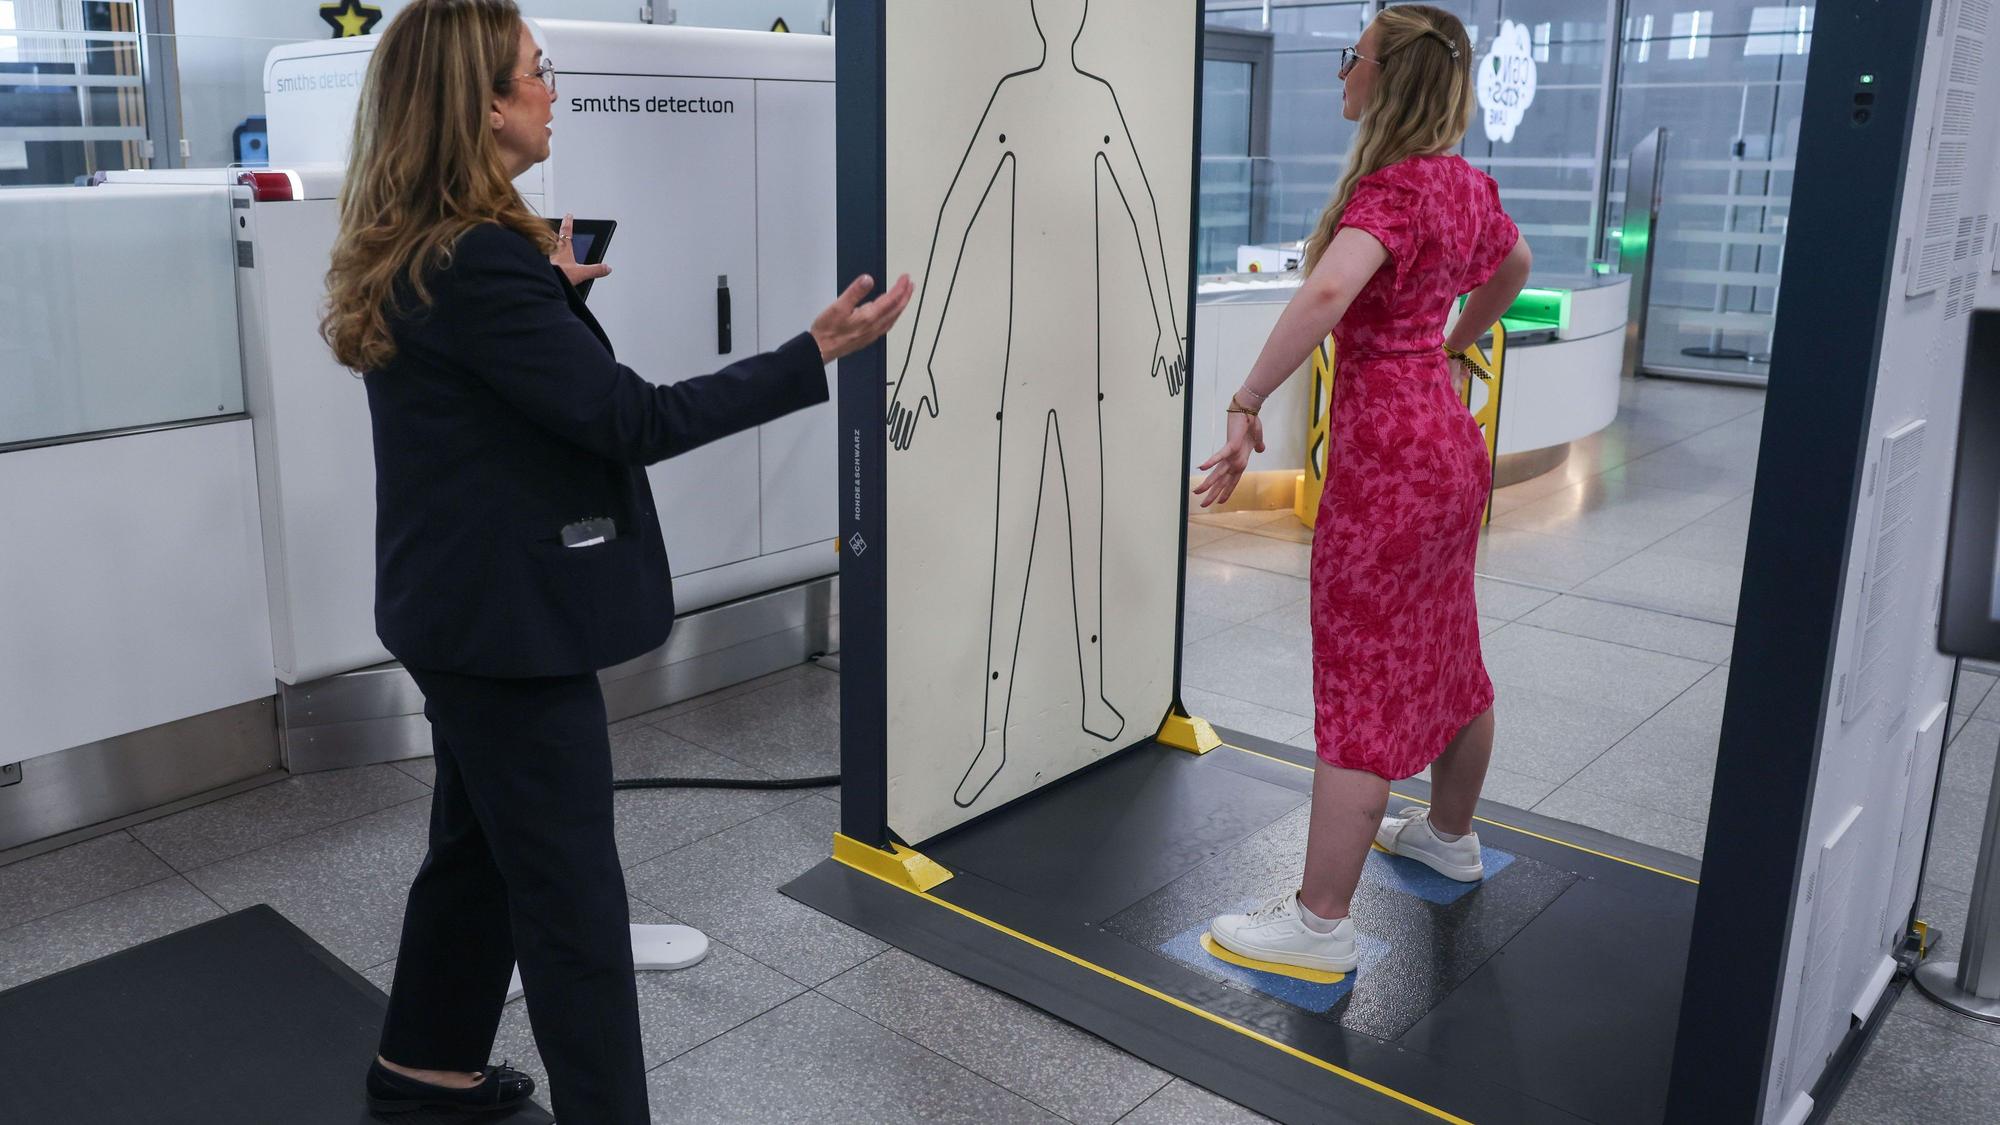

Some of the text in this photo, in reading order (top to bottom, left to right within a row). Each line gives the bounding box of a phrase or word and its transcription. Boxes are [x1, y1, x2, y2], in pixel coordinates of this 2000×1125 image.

[277, 69, 361, 92] smiths detect
[571, 95, 734, 113] smiths detection
